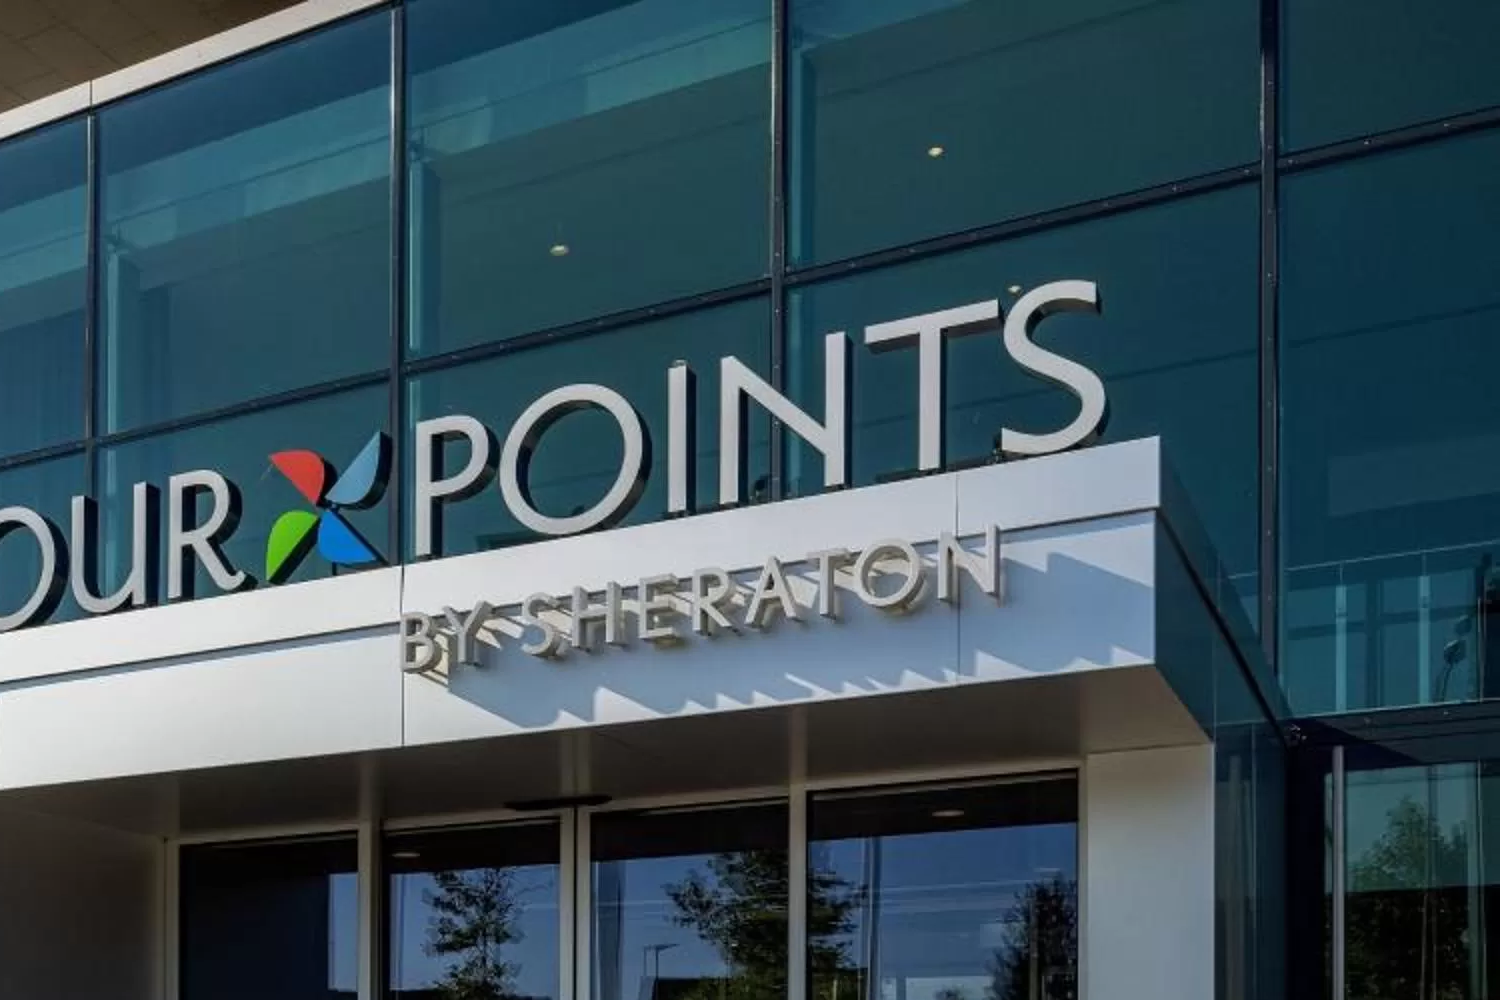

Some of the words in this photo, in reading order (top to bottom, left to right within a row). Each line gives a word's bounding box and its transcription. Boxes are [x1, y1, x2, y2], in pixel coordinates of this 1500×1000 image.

[414, 279, 1108, 558] POINTS
[400, 599, 493, 674] BY
[517, 523, 1003, 660] SHERATON
